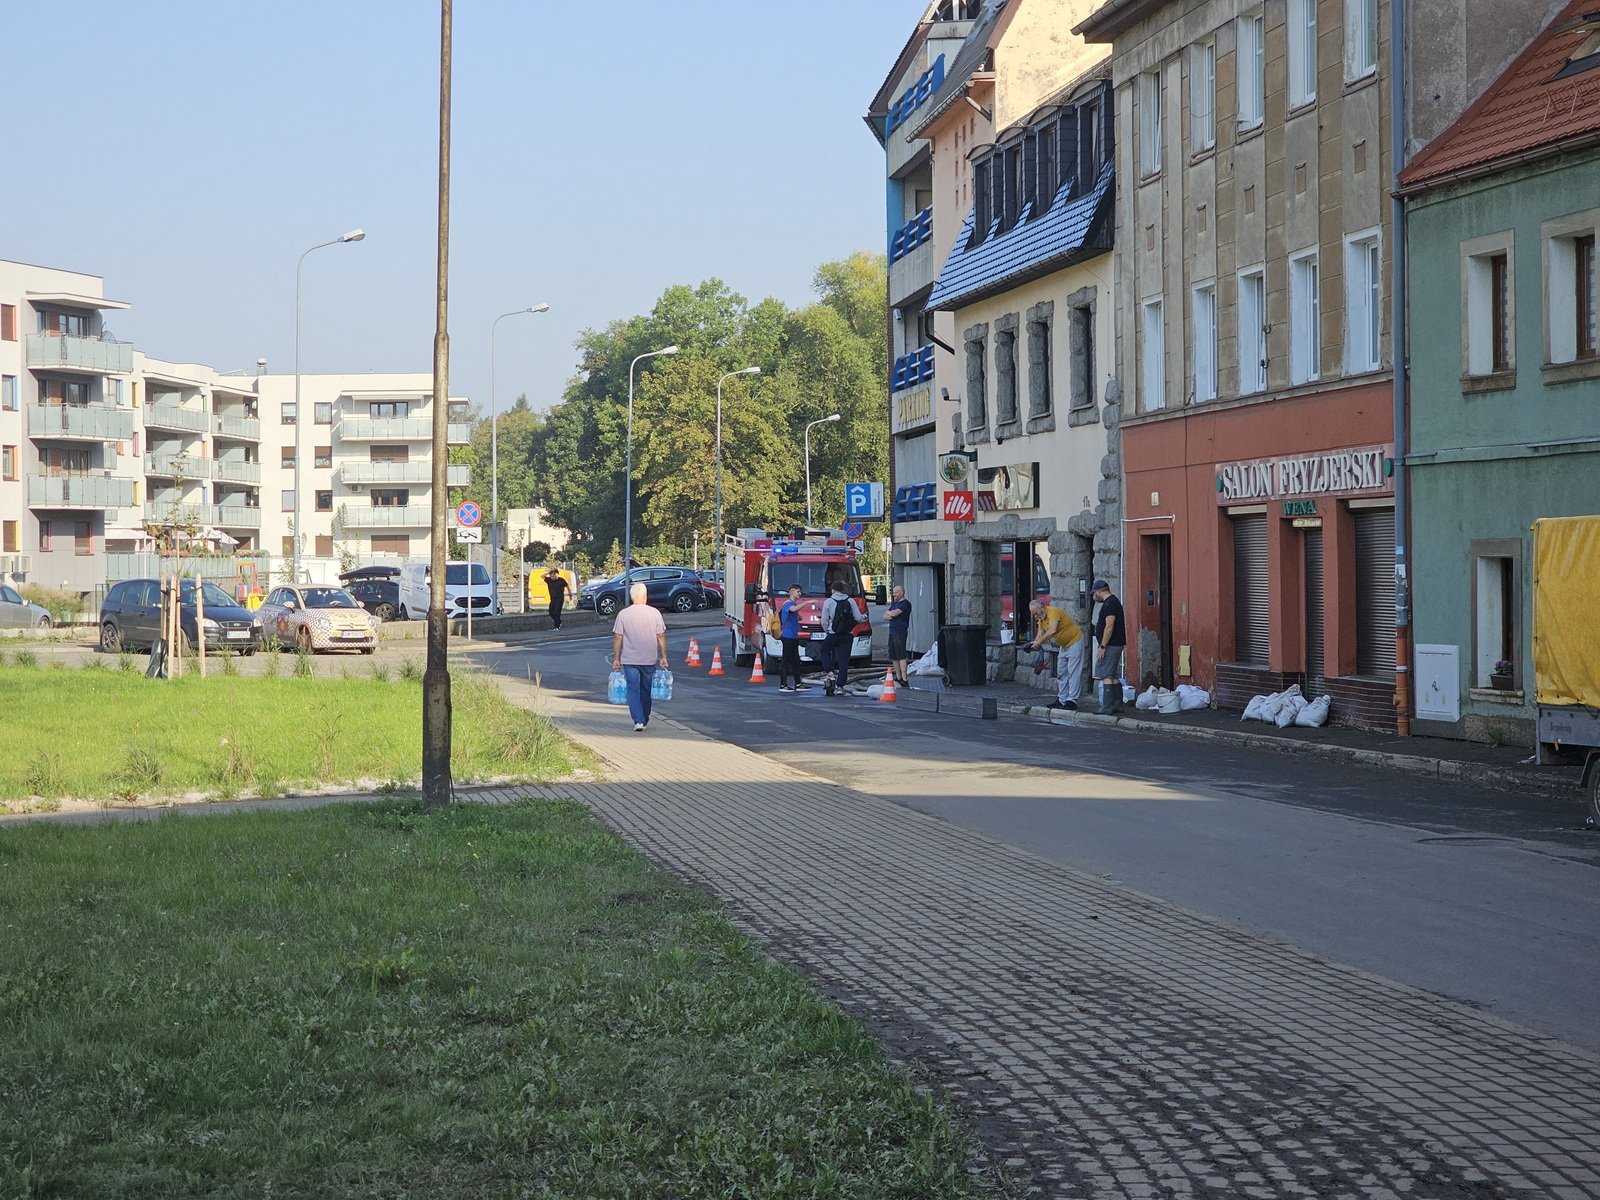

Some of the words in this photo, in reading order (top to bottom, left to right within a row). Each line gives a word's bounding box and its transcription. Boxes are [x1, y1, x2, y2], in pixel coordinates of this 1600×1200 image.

[1223, 462, 1274, 500] SALON
[1278, 449, 1385, 495] FRYZJERSKI
[851, 494, 866, 514] P
[945, 495, 971, 518] illy
[1282, 500, 1317, 515] WENA
